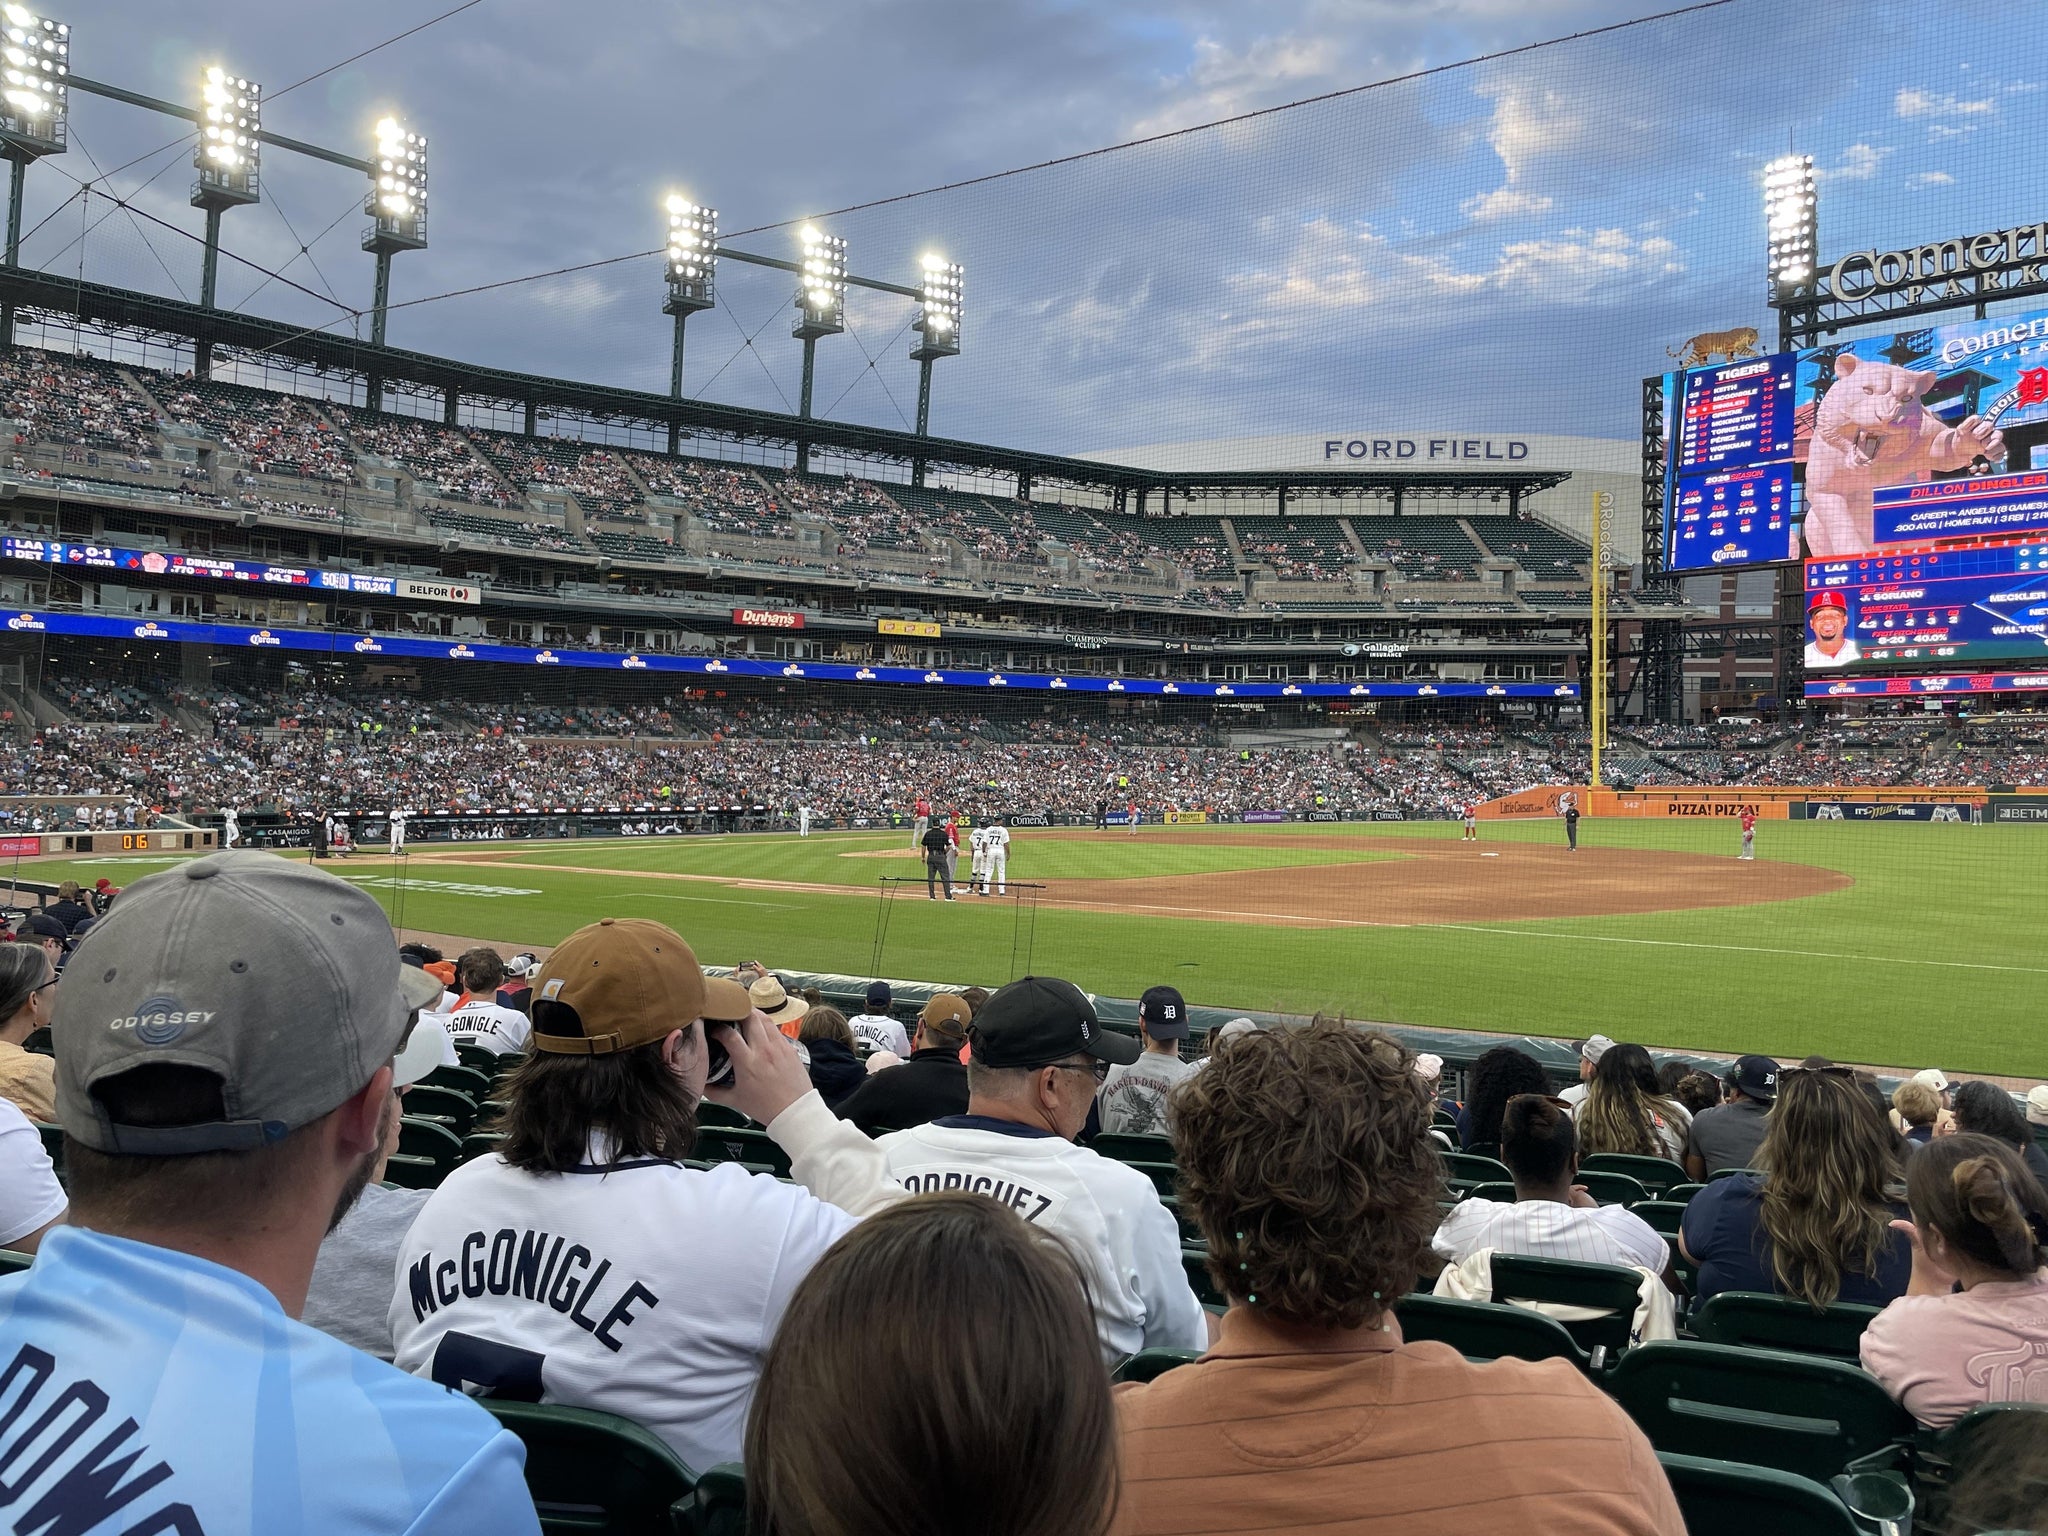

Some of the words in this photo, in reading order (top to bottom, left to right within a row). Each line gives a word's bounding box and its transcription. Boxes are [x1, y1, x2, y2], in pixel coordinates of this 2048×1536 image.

[1906, 264, 2042, 306] PARK
[1715, 362, 1770, 381] TIGERS
[1712, 388, 1758, 402] MCGONIGLE
[1713, 384, 1738, 394] KEITH
[1712, 399, 1746, 410] DINGLER
[1711, 408, 1744, 419] GREENE
[1711, 413, 1757, 427] MCKINSTRY
[1710, 422, 1757, 436] TORKELSON
[1325, 439, 1417, 460] FORD
[1429, 439, 1529, 460] FIELD
[1710, 440, 1752, 453] WORKMAN
[1709, 453, 1725, 462] LEE
[1705, 474, 1731, 485] 2026
[1910, 483, 1965, 498] DILLON
[1968, 474, 2047, 492] DINGLER
[1740, 489, 1754, 497] 32
[1770, 485, 1782, 493] 10
[1735, 506, 1757, 515] .770
[1771, 503, 1780, 511] 0
[1910, 511, 1949, 521] CAREER
[1958, 506, 1996, 516] ANGELS
[1894, 523, 1916, 533] .300
[1916, 521, 1937, 531] AVG
[1945, 518, 1972, 528] HOME
[1972, 516, 1992, 526] RUN
[2000, 515, 2009, 523] 3
[2008, 513, 2025, 522] RBI
[2031, 512, 2040, 520] 2
[1600, 508, 1614, 570] Rocket
[1683, 531, 1696, 539] 41
[15, 539, 44, 550] LAA
[51, 542, 62, 552] 0
[86, 547, 112, 559] 0-1
[186, 558, 235, 570] DINGLER
[1712, 549, 1748, 563] Corona
[1825, 564, 1848, 573] LAA
[1859, 562, 1869, 570] 0
[1876, 560, 1886, 568] 0
[1893, 559, 1903, 567] 0
[1911, 557, 1921, 565] 0
[1928, 556, 1938, 564] 0
[2019, 548, 2030, 557] 0
[2039, 547, 2048, 555] 2
[15, 550, 44, 561] DET
[51, 553, 62, 563] 2
[170, 565, 195, 575] .770
[210, 569, 224, 578] 10
[234, 571, 249, 580] 32
[264, 572, 292, 584] 94.3
[1825, 576, 1848, 585] DET
[1893, 571, 1903, 580] 0
[1911, 570, 1921, 579] 0
[2020, 561, 2030, 570] 2
[354, 580, 391, 593] $10,244
[409, 584, 448, 597] BELFOR
[1860, 594, 1870, 602] J.
[1873, 591, 1924, 601] SORIANO
[1989, 591, 2046, 603] MECKLER
[8, 617, 46, 630] Corona
[742, 610, 796, 625] Dunham's
[1883, 620, 1894, 628] 6
[1904, 618, 1915, 627] 2
[1926, 617, 1937, 625] 3
[1948, 616, 1958, 624] 2
[134, 625, 168, 638] Corona
[1992, 624, 2045, 635] WALTON
[250, 633, 280, 646] Corona
[1065, 634, 1108, 645] CHAMPIONS
[1913, 634, 1948, 642] 40.0%
[354, 641, 382, 653] Corona
[449, 647, 475, 660] Corona
[1362, 642, 1409, 653] Gallagher
[535, 652, 559, 663] Corona
[622, 657, 646, 669] Corona
[1920, 679, 1949, 687] 94.3
[2012, 676, 2048, 687] SINKE
[1828, 686, 1855, 695] Corona
[1872, 719, 1943, 727] CHEVROLET
[1668, 803, 1711, 816] PIZZA!
[1867, 804, 1903, 820] Miller
[1897, 808, 1916, 816] TIME
[2011, 808, 2048, 819] BETM
[1244, 814, 1263, 823] planet
[1263, 814, 1282, 822] fitness
[267, 828, 310, 836] CASAMIGOS
[976, 837, 982, 847] 7
[989, 835, 1001, 845] 77
[1163, 1004, 1176, 1019] D
[110, 1011, 217, 1031] ODYSSEY
[444, 1015, 502, 1035] cGONIGLE
[409, 1227, 660, 1354] McGONIGLE
